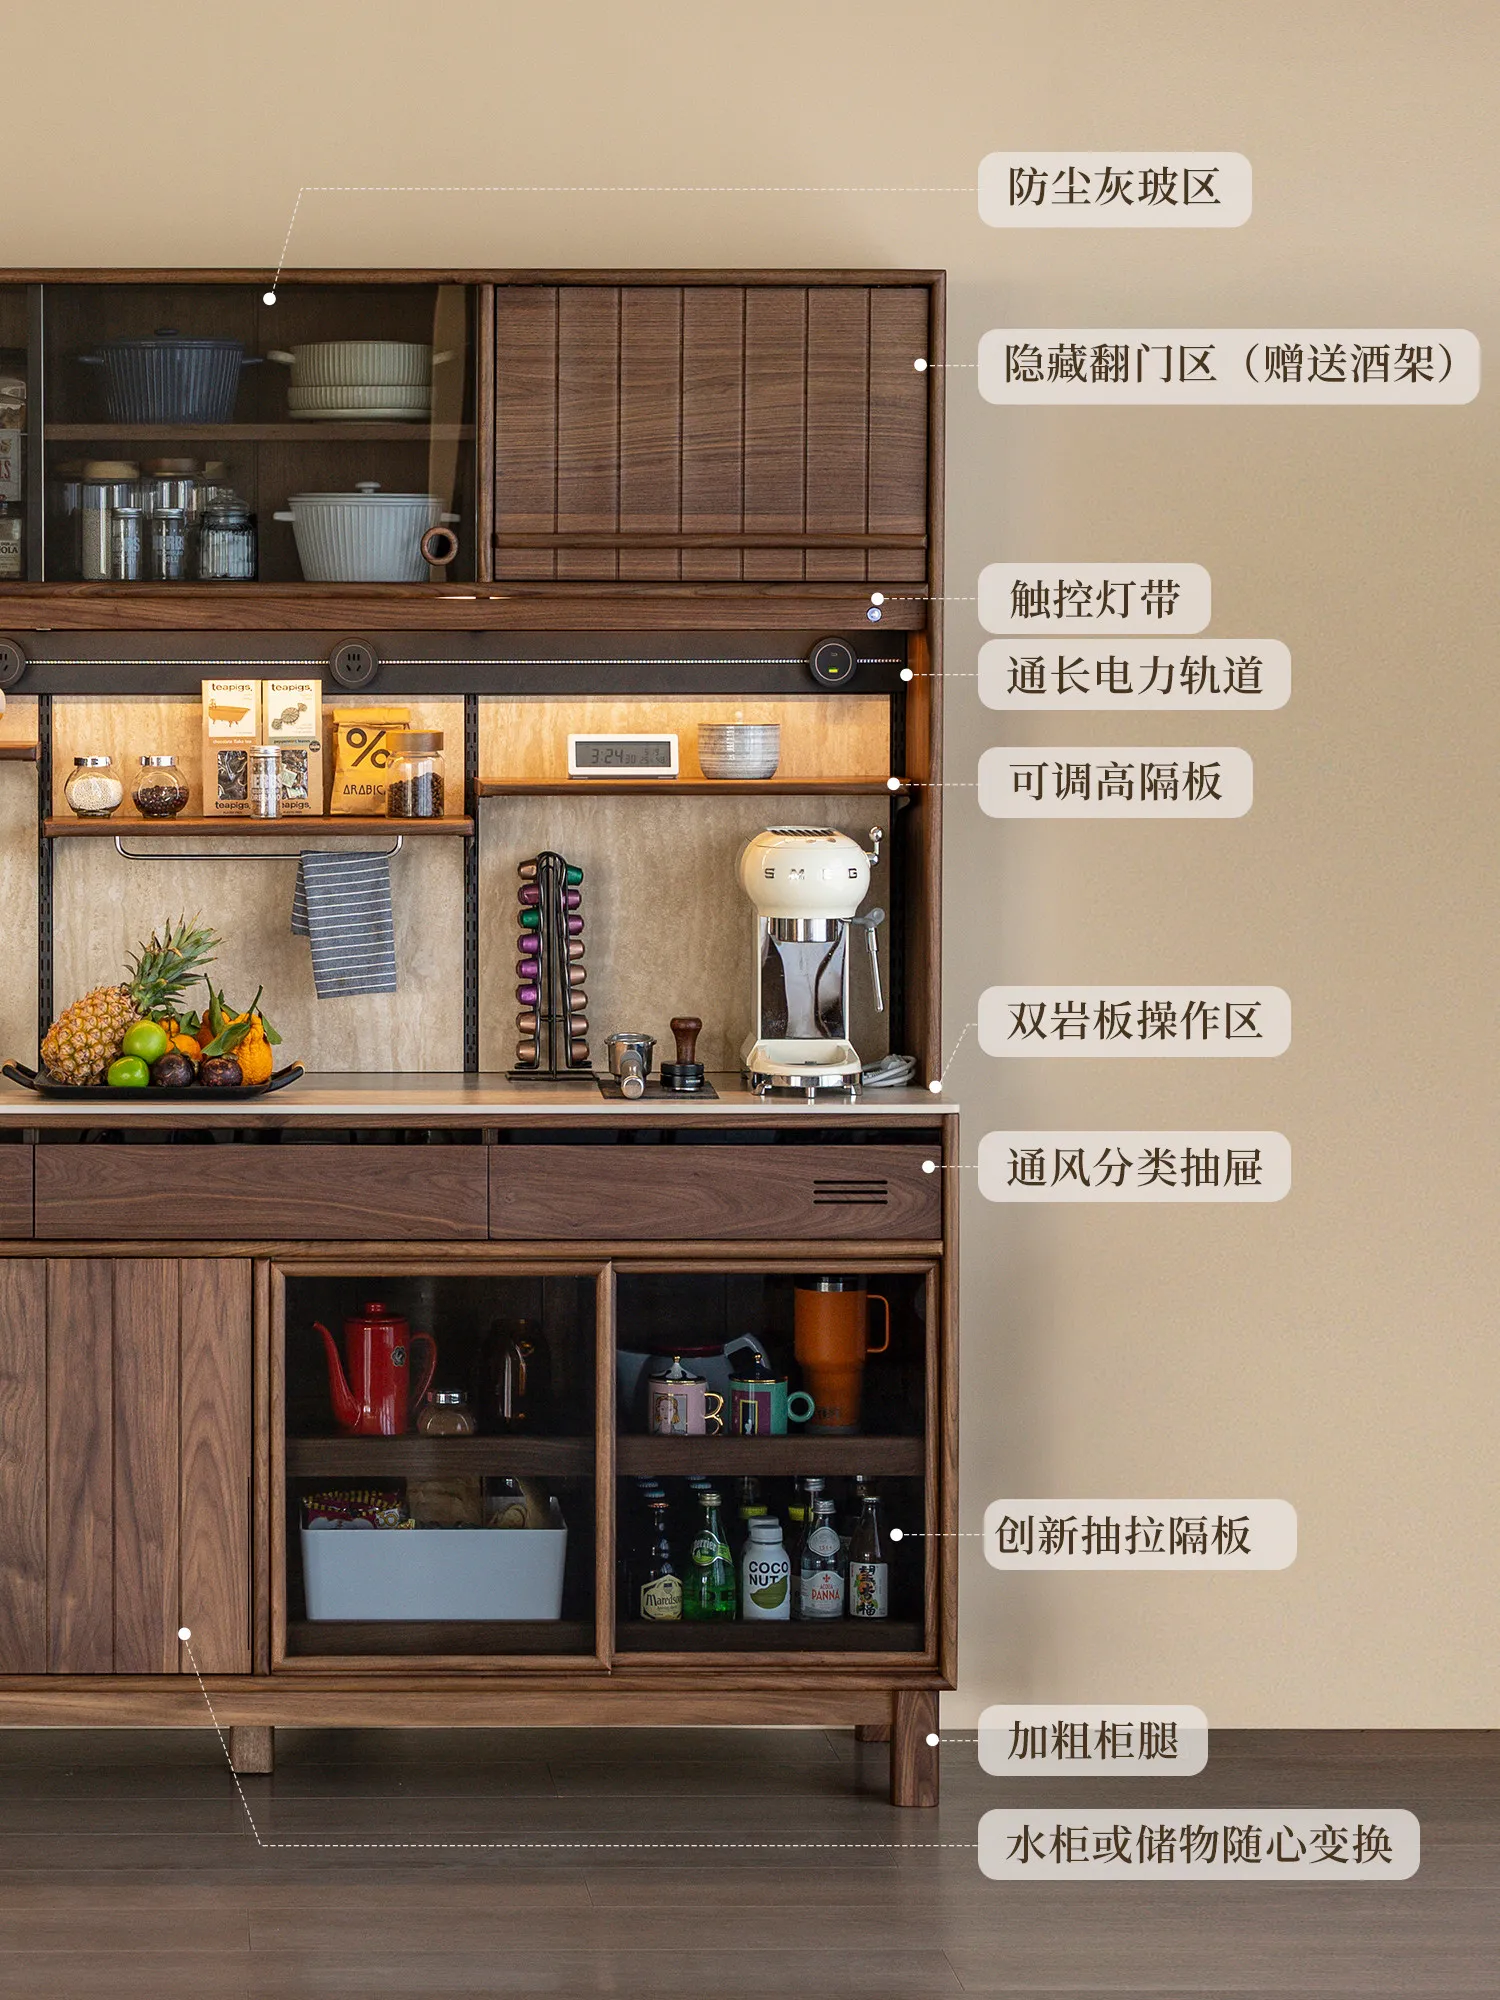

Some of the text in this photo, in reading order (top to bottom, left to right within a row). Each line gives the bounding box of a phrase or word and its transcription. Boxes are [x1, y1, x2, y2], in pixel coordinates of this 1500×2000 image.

[591, 748, 623, 764] 3:24
[343, 784, 386, 795] ARABIC
[748, 1560, 789, 1575] COCO
[748, 1573, 779, 1587] NUT
[811, 1588, 841, 1601] PANNA
